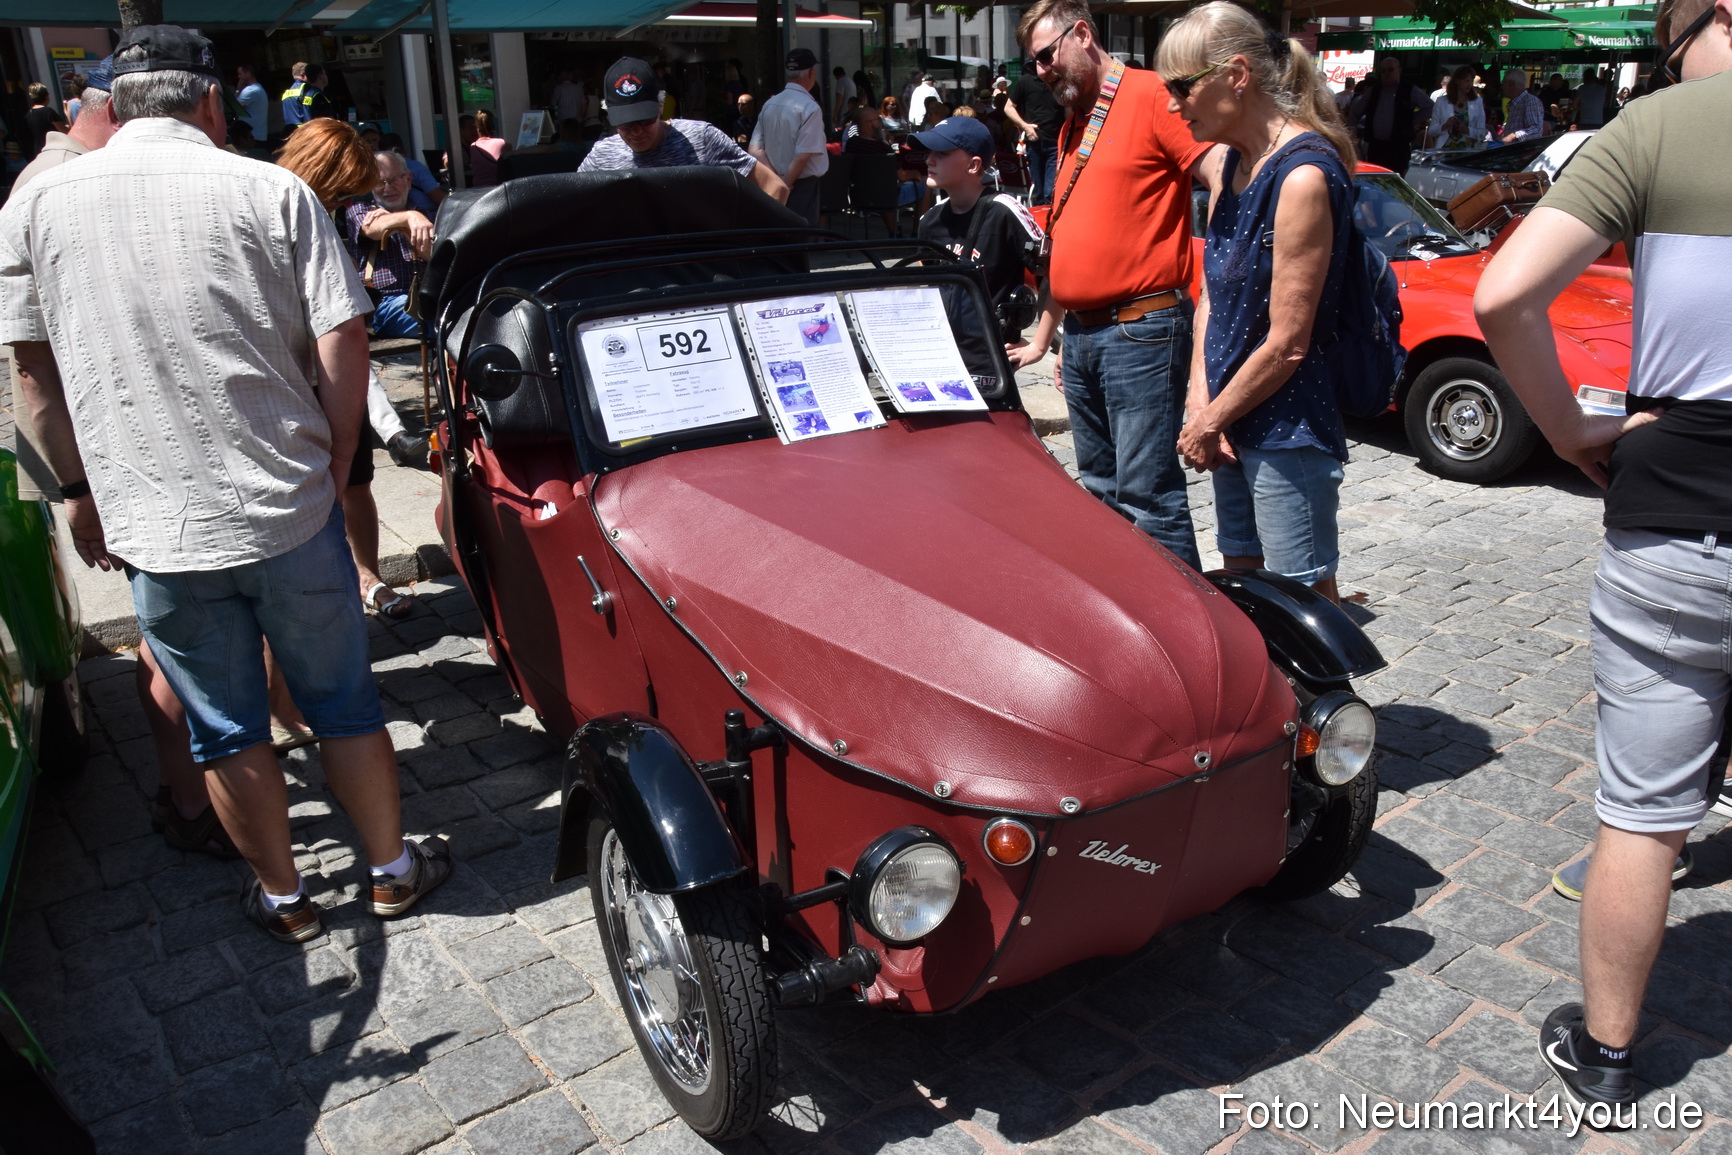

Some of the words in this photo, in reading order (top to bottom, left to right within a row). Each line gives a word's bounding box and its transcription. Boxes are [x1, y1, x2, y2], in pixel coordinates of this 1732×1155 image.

[1379, 36, 1433, 47] Neumarkter
[1588, 35, 1645, 46] Neumarkter
[659, 329, 712, 358] 592
[1079, 840, 1162, 875] Velorex
